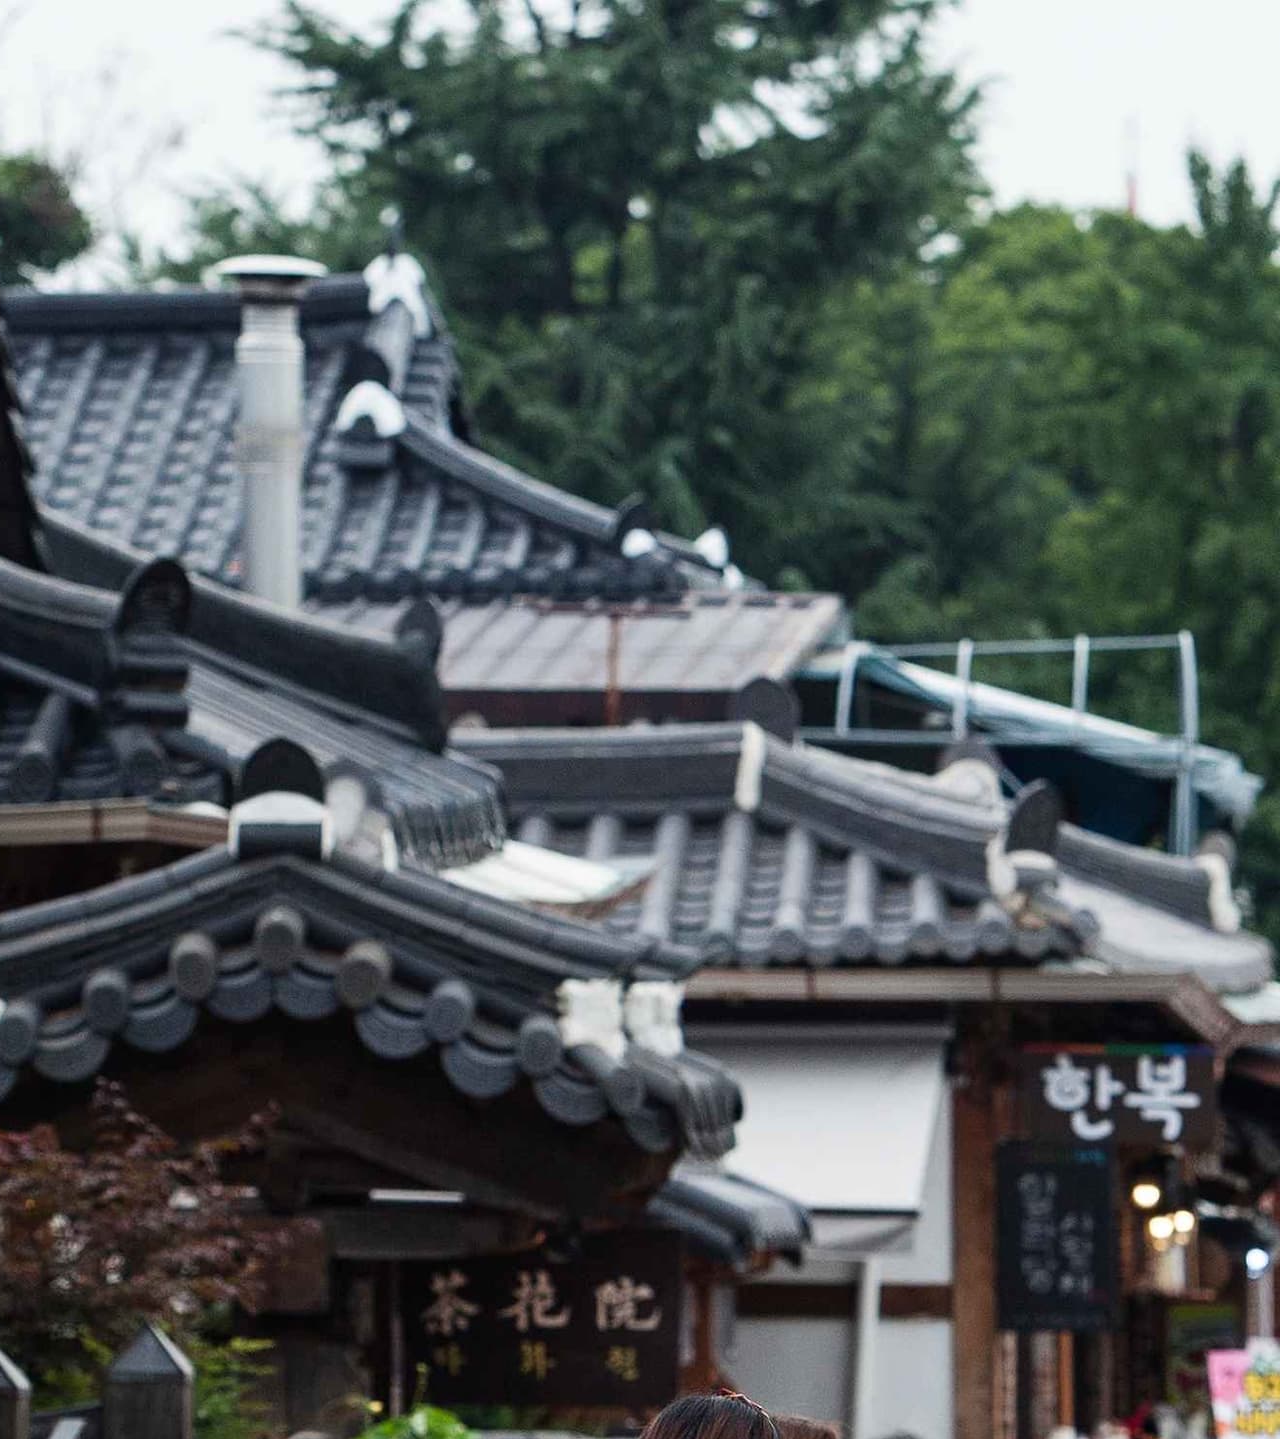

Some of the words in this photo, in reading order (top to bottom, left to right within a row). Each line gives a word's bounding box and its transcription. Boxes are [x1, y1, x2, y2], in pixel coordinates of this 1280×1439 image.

[1040, 1054, 1202, 1141] 한복
[421, 1269, 663, 1335] 茶花院
